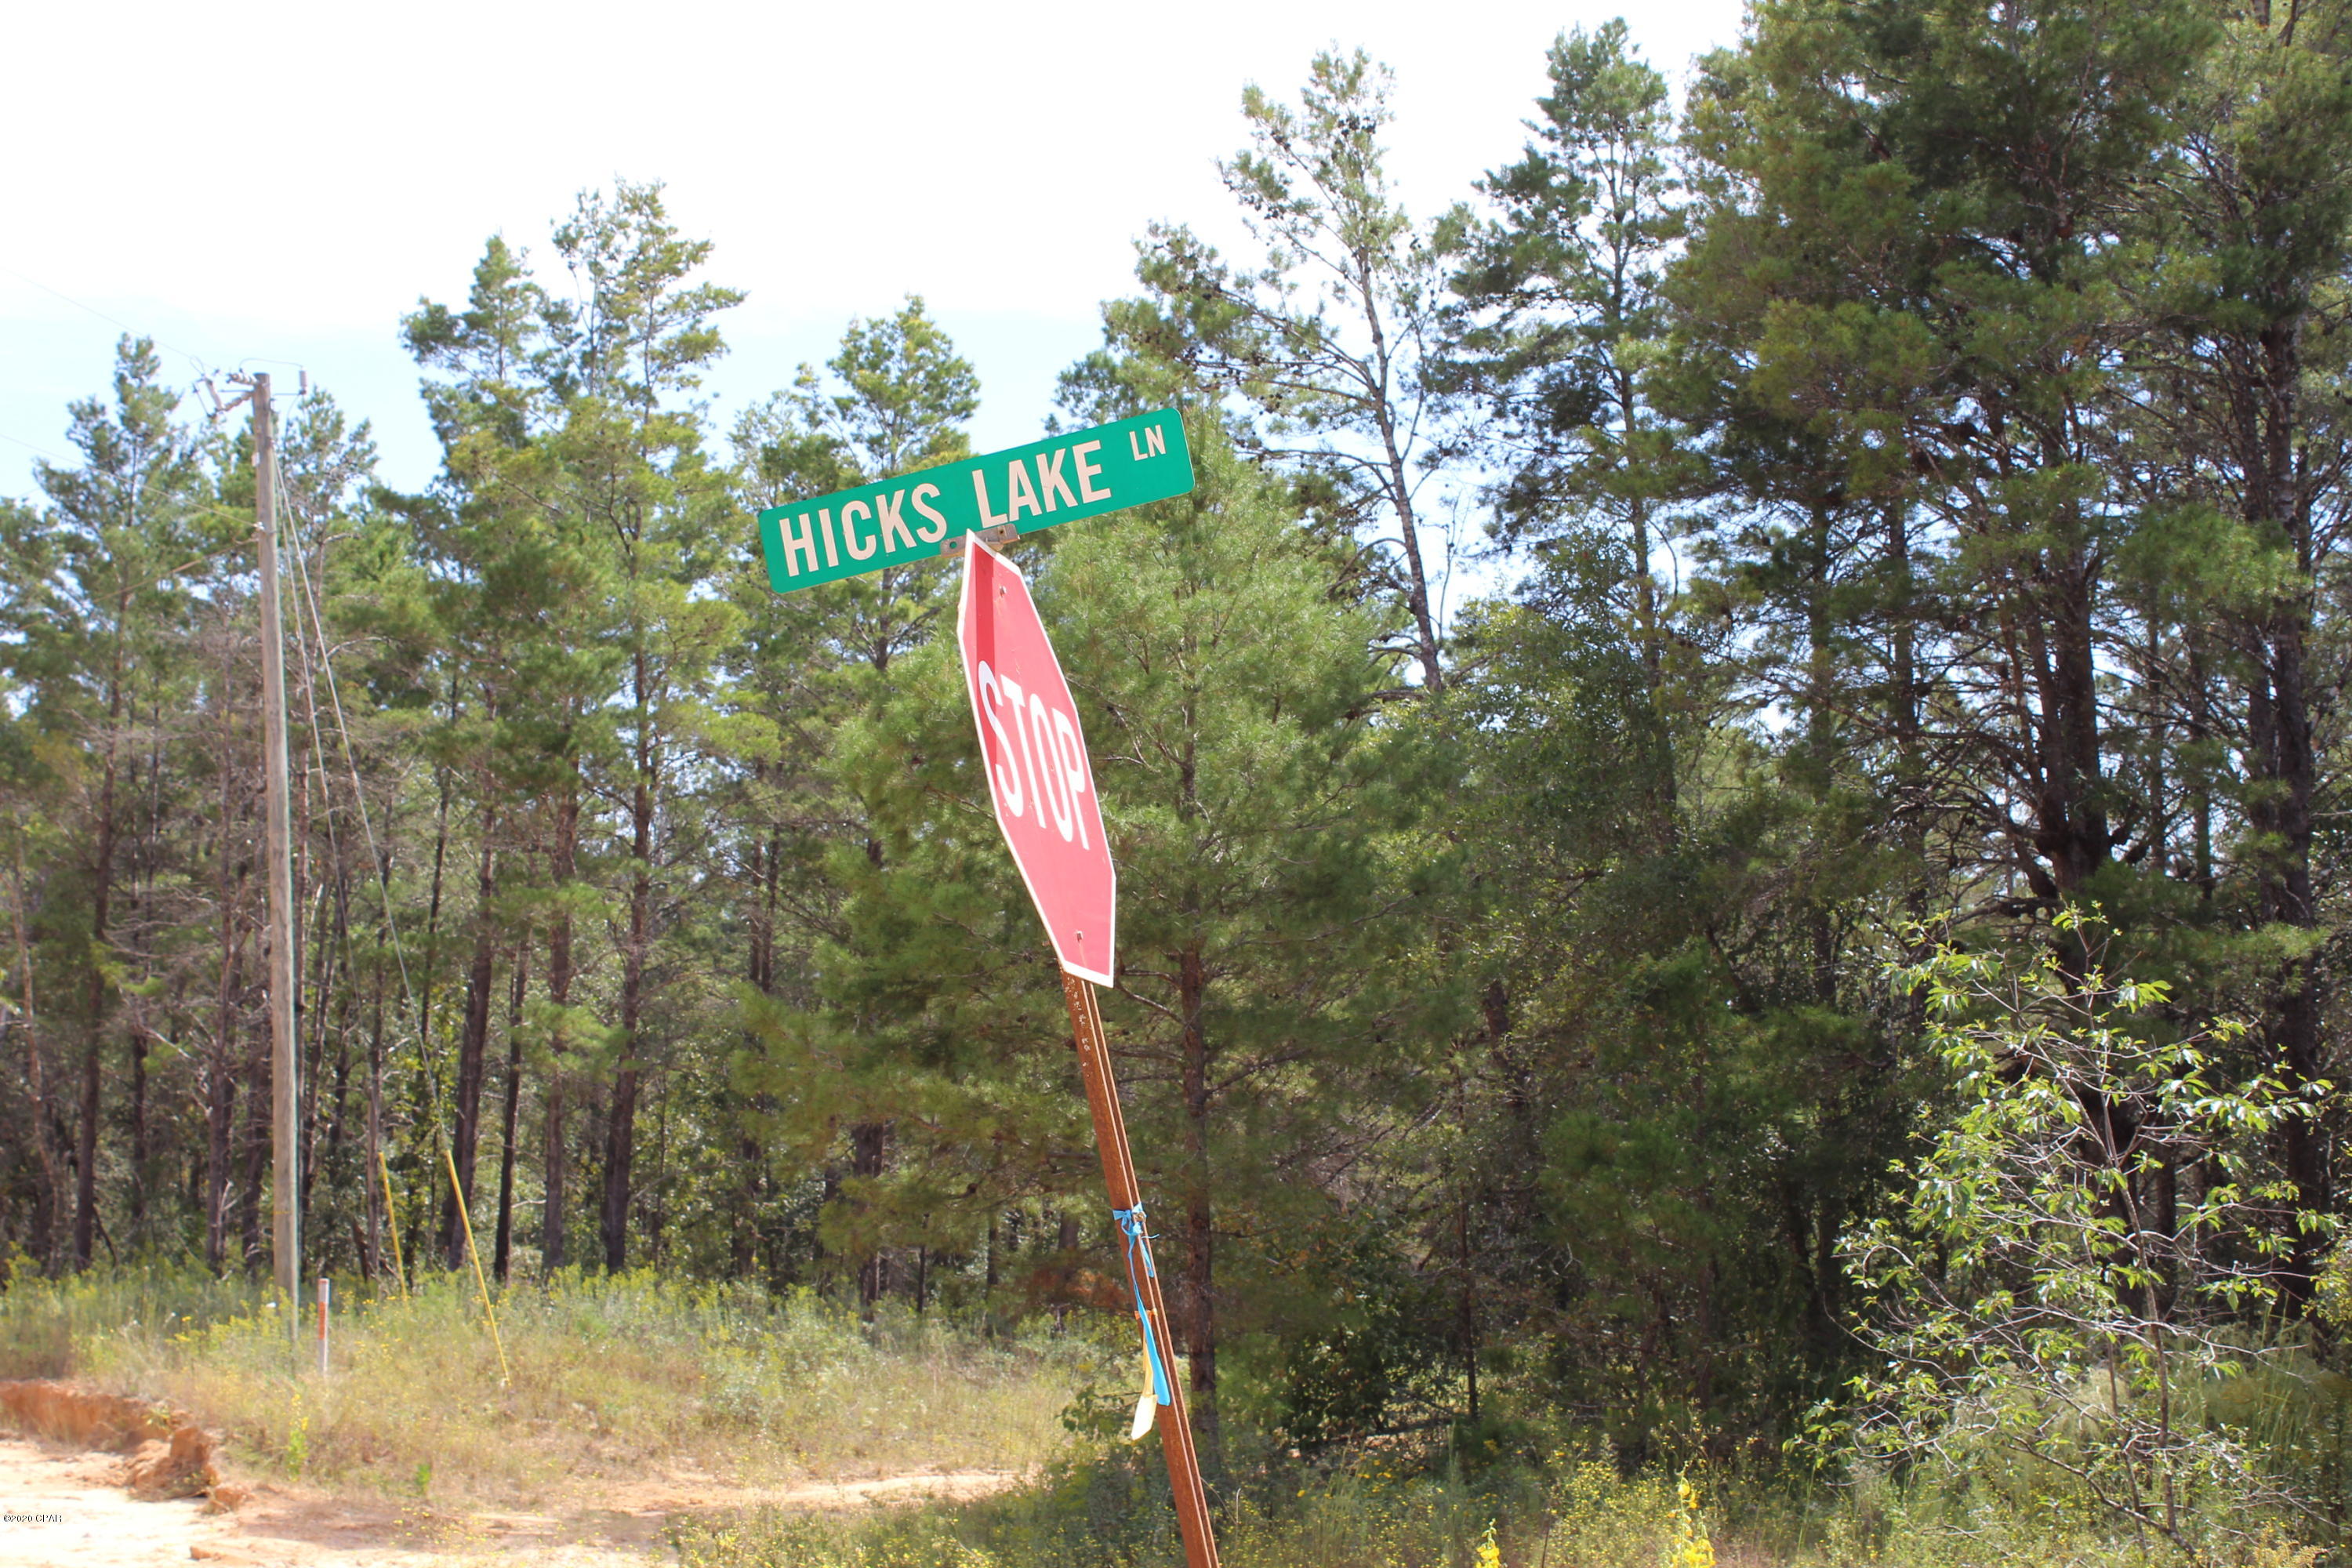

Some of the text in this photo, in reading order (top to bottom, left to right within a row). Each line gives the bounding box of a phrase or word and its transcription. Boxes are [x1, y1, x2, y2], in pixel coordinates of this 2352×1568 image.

[779, 424, 1167, 577] HICKS LAKE LN
[978, 660, 1090, 850] STOP
